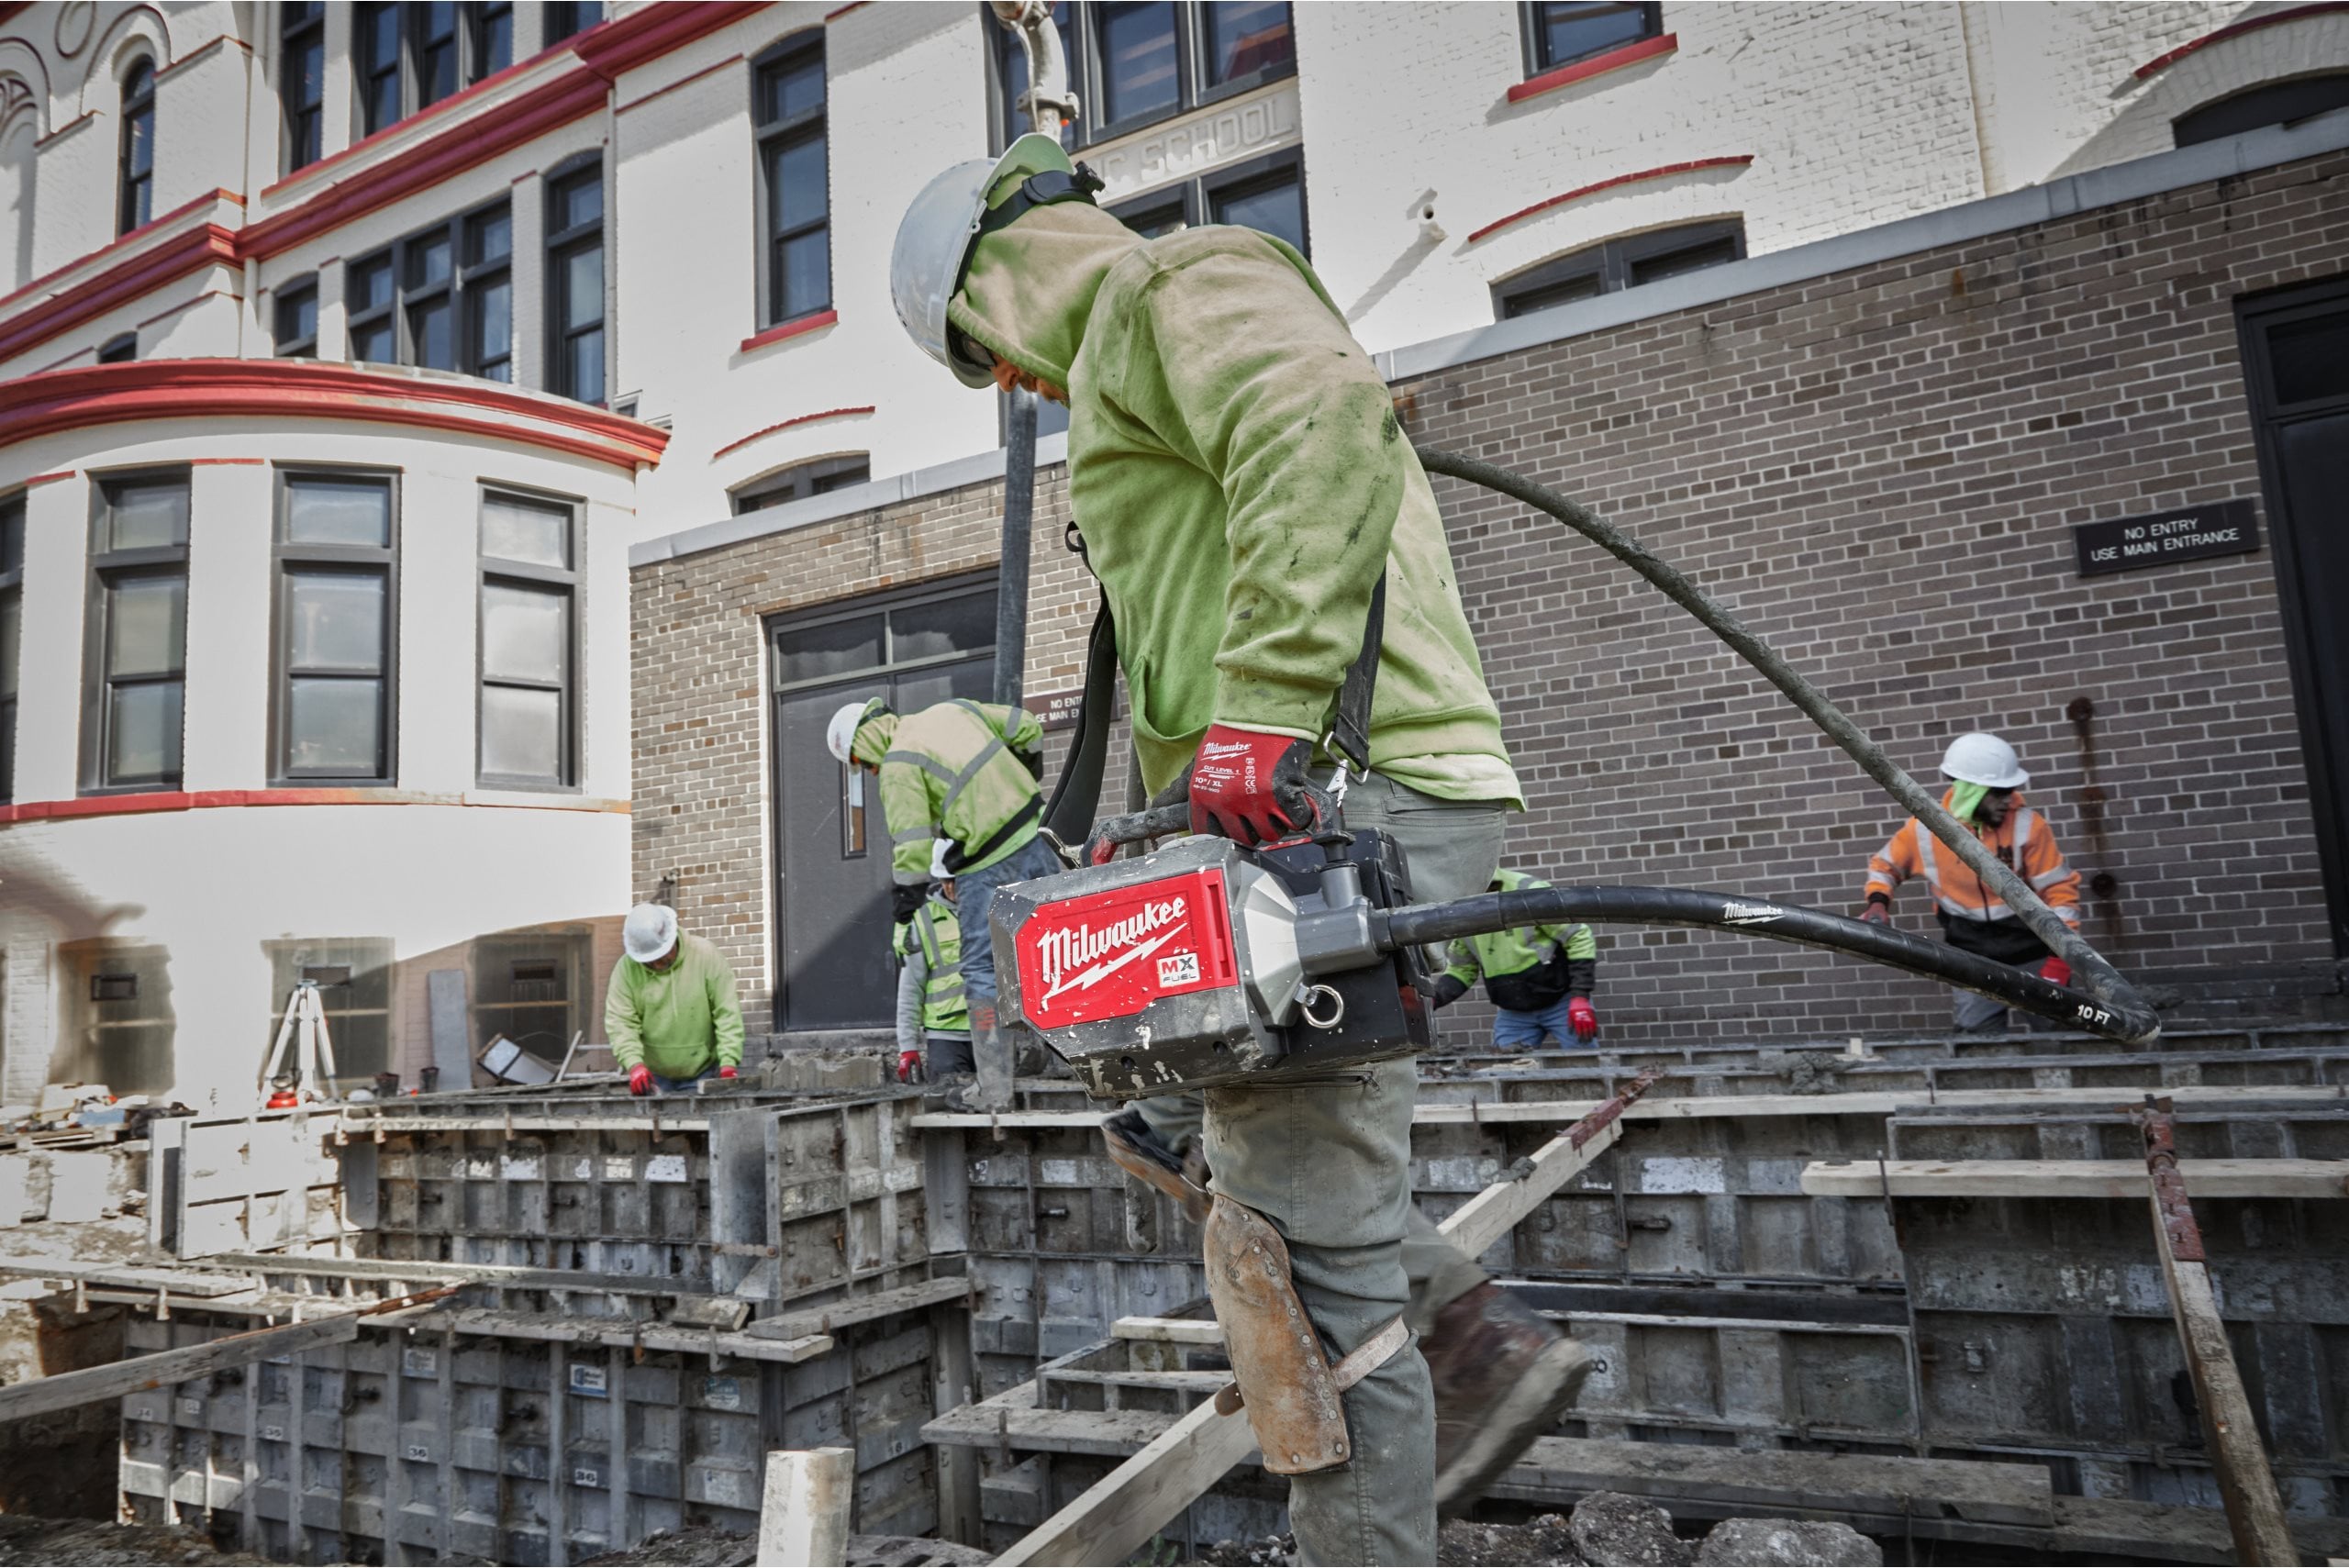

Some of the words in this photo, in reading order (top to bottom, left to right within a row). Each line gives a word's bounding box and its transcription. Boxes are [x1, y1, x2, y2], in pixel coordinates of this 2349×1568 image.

[1141, 96, 1294, 183] SCHOOL
[2124, 527, 2146, 540] NO
[2150, 517, 2199, 538] ENTRY
[2090, 546, 2120, 562] USE
[2123, 542, 2159, 557] MAIN
[2164, 528, 2241, 550] ENTRANCE
[1050, 699, 1063, 709] NO
[1064, 695, 1083, 707] ENT
[1035, 713, 1048, 723] SE
[1049, 710, 1069, 721] MAIN
[1203, 741, 1252, 756] Milwaukee
[1721, 901, 1785, 919] Milwaukee
[1037, 896, 1186, 984] Milwaukee
[1161, 956, 1196, 974] MX
[1163, 973, 1197, 984] FUEL
[2076, 1004, 2093, 1019] 10
[2093, 1009, 2110, 1025] FT
